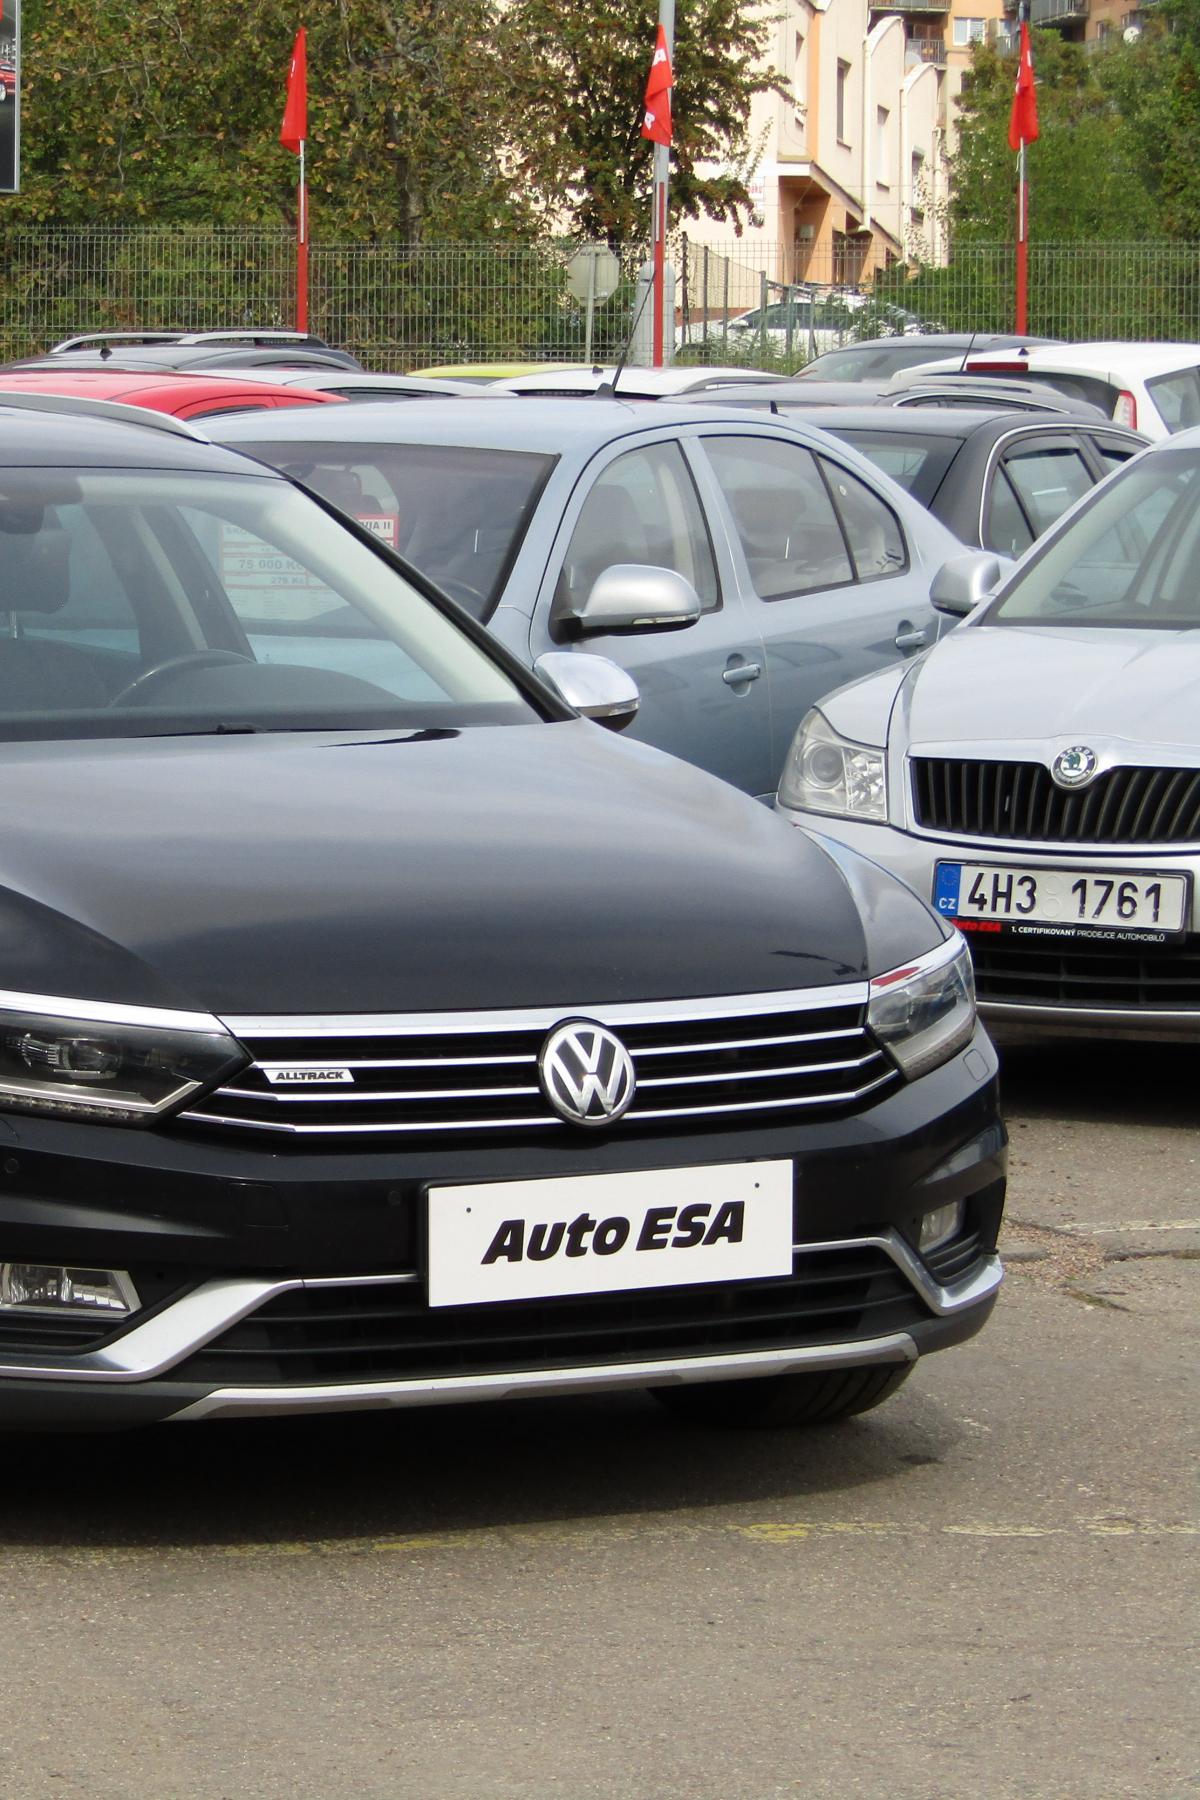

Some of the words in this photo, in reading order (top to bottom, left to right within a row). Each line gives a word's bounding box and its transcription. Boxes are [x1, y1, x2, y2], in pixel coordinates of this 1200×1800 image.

[239, 559, 254, 569] 75
[259, 559, 282, 569] 000
[939, 897, 956, 910] CZ
[967, 872, 1037, 914] 4H3
[1071, 878, 1162, 923] 1761
[1018, 926, 1075, 936] CERTIFIKOVANÝ
[1076, 930, 1116, 939] PRODEJCE
[275, 1071, 344, 1081] ALLTRACK
[480, 1213, 630, 1265] Auto
[636, 1200, 745, 1251] ESA
